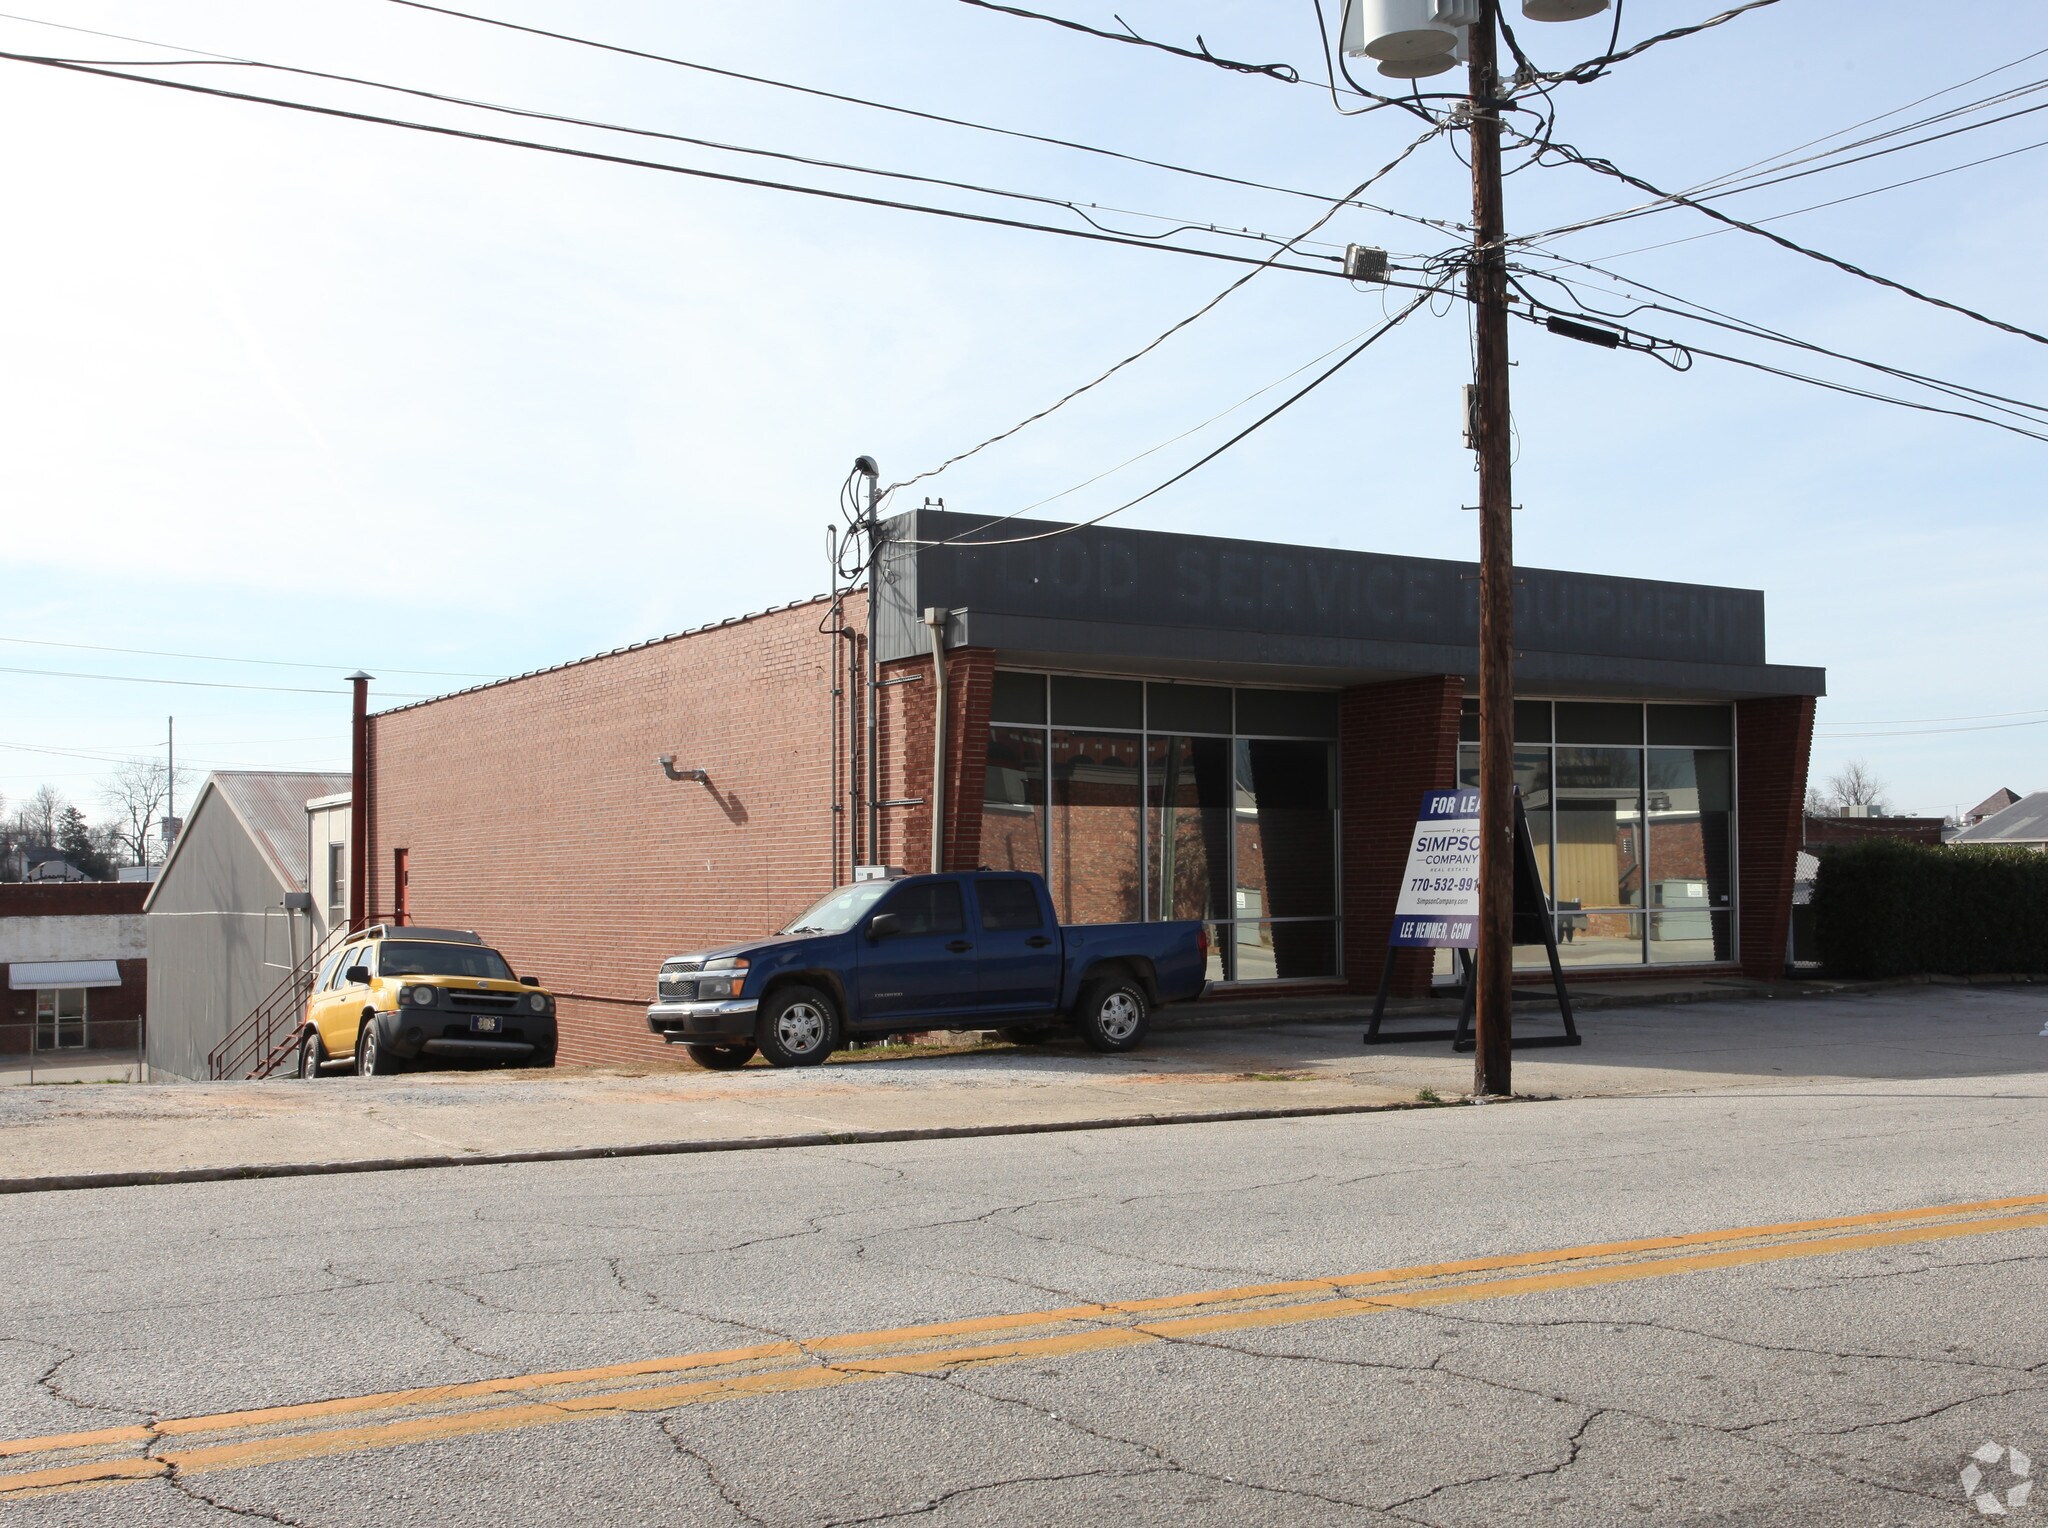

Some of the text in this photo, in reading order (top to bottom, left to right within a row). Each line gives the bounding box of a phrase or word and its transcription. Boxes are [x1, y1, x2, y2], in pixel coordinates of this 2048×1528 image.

[1173, 547, 1437, 623] SERVICE
[1429, 795, 1480, 814] FOR LEA
[1416, 836, 1480, 853] SIMPSO
[1425, 854, 1479, 865] COMPANY
[1411, 877, 1479, 892] 770-532-991
[1416, 897, 1469, 906] SimpsonCompany.com
[1400, 921, 1472, 941] LEE HEMMER, CCIM
